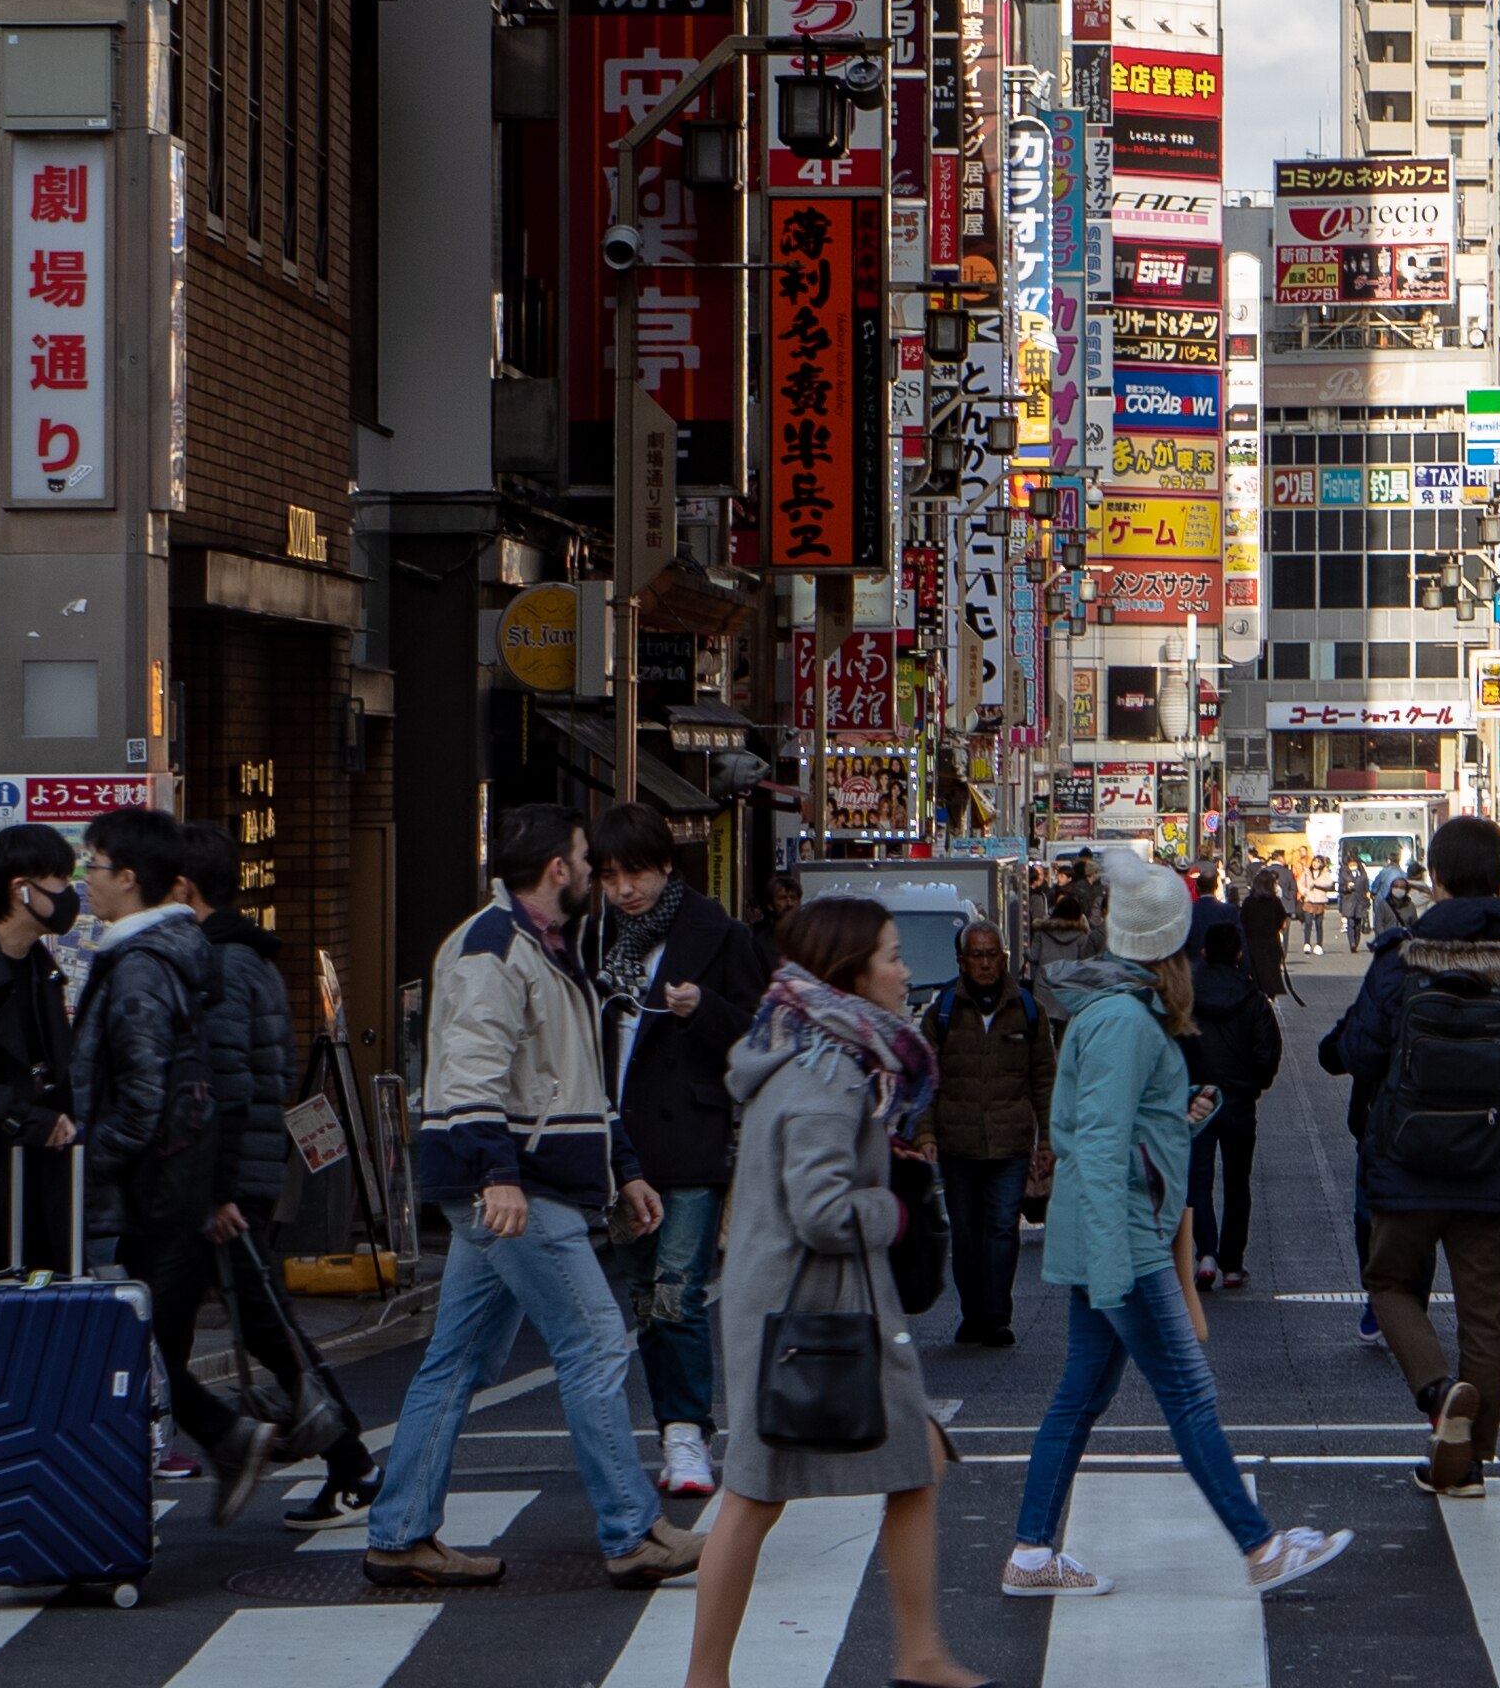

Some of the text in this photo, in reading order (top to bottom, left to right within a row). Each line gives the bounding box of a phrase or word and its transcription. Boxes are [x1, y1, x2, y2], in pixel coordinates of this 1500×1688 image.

[1111, 62, 1217, 100] 全店営業中
[797, 161, 852, 184] 4F
[1093, 141, 1113, 211] カラオケ
[1280, 165, 1447, 189] コミック&ネットカフェ
[1009, 131, 1045, 283] カラオケ
[1319, 197, 1439, 238] aprecio
[1087, 223, 1102, 286] SEGA
[1280, 247, 1339, 263] 新宿最大
[30, 165, 89, 473] 劇場通り
[1087, 320, 1102, 381] SEGA
[1140, 341, 1177, 362] ゴルフ
[1024, 348, 1046, 419] 麻雀
[1051, 286, 1079, 468] カラオケ
[1112, 437, 1215, 473] まんが喫茶
[646, 430, 665, 549] 劇場通り一番街
[1274, 470, 1315, 504] つり具
[1322, 472, 1362, 504] Fishing
[1369, 470, 1409, 504] 釣具
[1429, 467, 1460, 485] TAX
[1421, 489, 1454, 504] 免税
[1107, 515, 1177, 549] ゲーム
[1111, 571, 1212, 598] メンズサウナ
[1289, 705, 1454, 726] コーヒー ショップ クール
[1101, 787, 1153, 807] ゲーム
